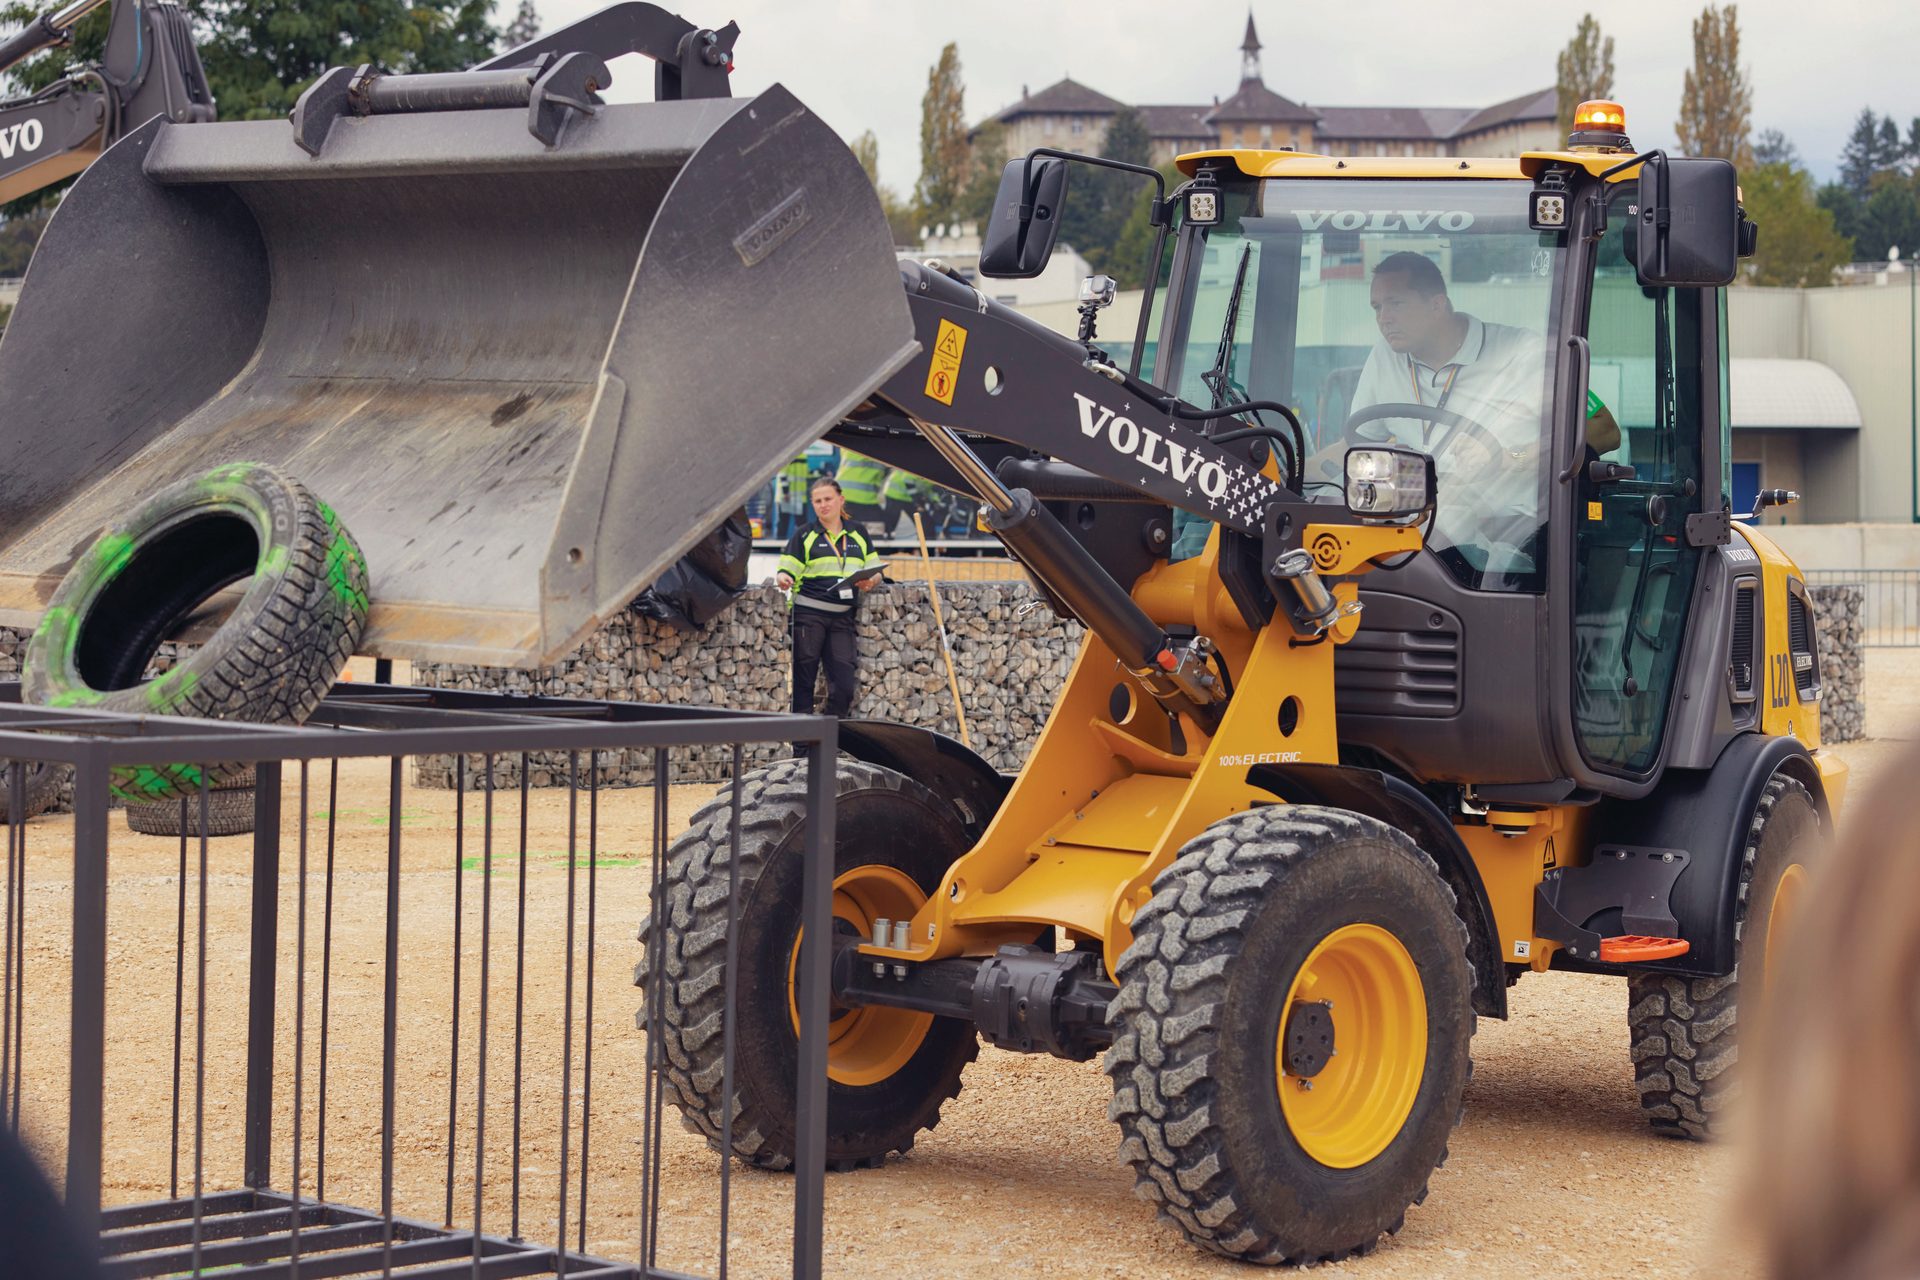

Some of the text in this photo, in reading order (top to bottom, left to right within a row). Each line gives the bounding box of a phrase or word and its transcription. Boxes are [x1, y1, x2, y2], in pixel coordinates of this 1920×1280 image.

[747, 201, 806, 254] VOLVO
[1290, 209, 1475, 232] VOLVO
[1073, 391, 1229, 499] VOLVO
[1725, 548, 1756, 562] VOLVO
[1770, 653, 1790, 708] L20
[1219, 751, 1302, 767] 100% ELECTRIC
